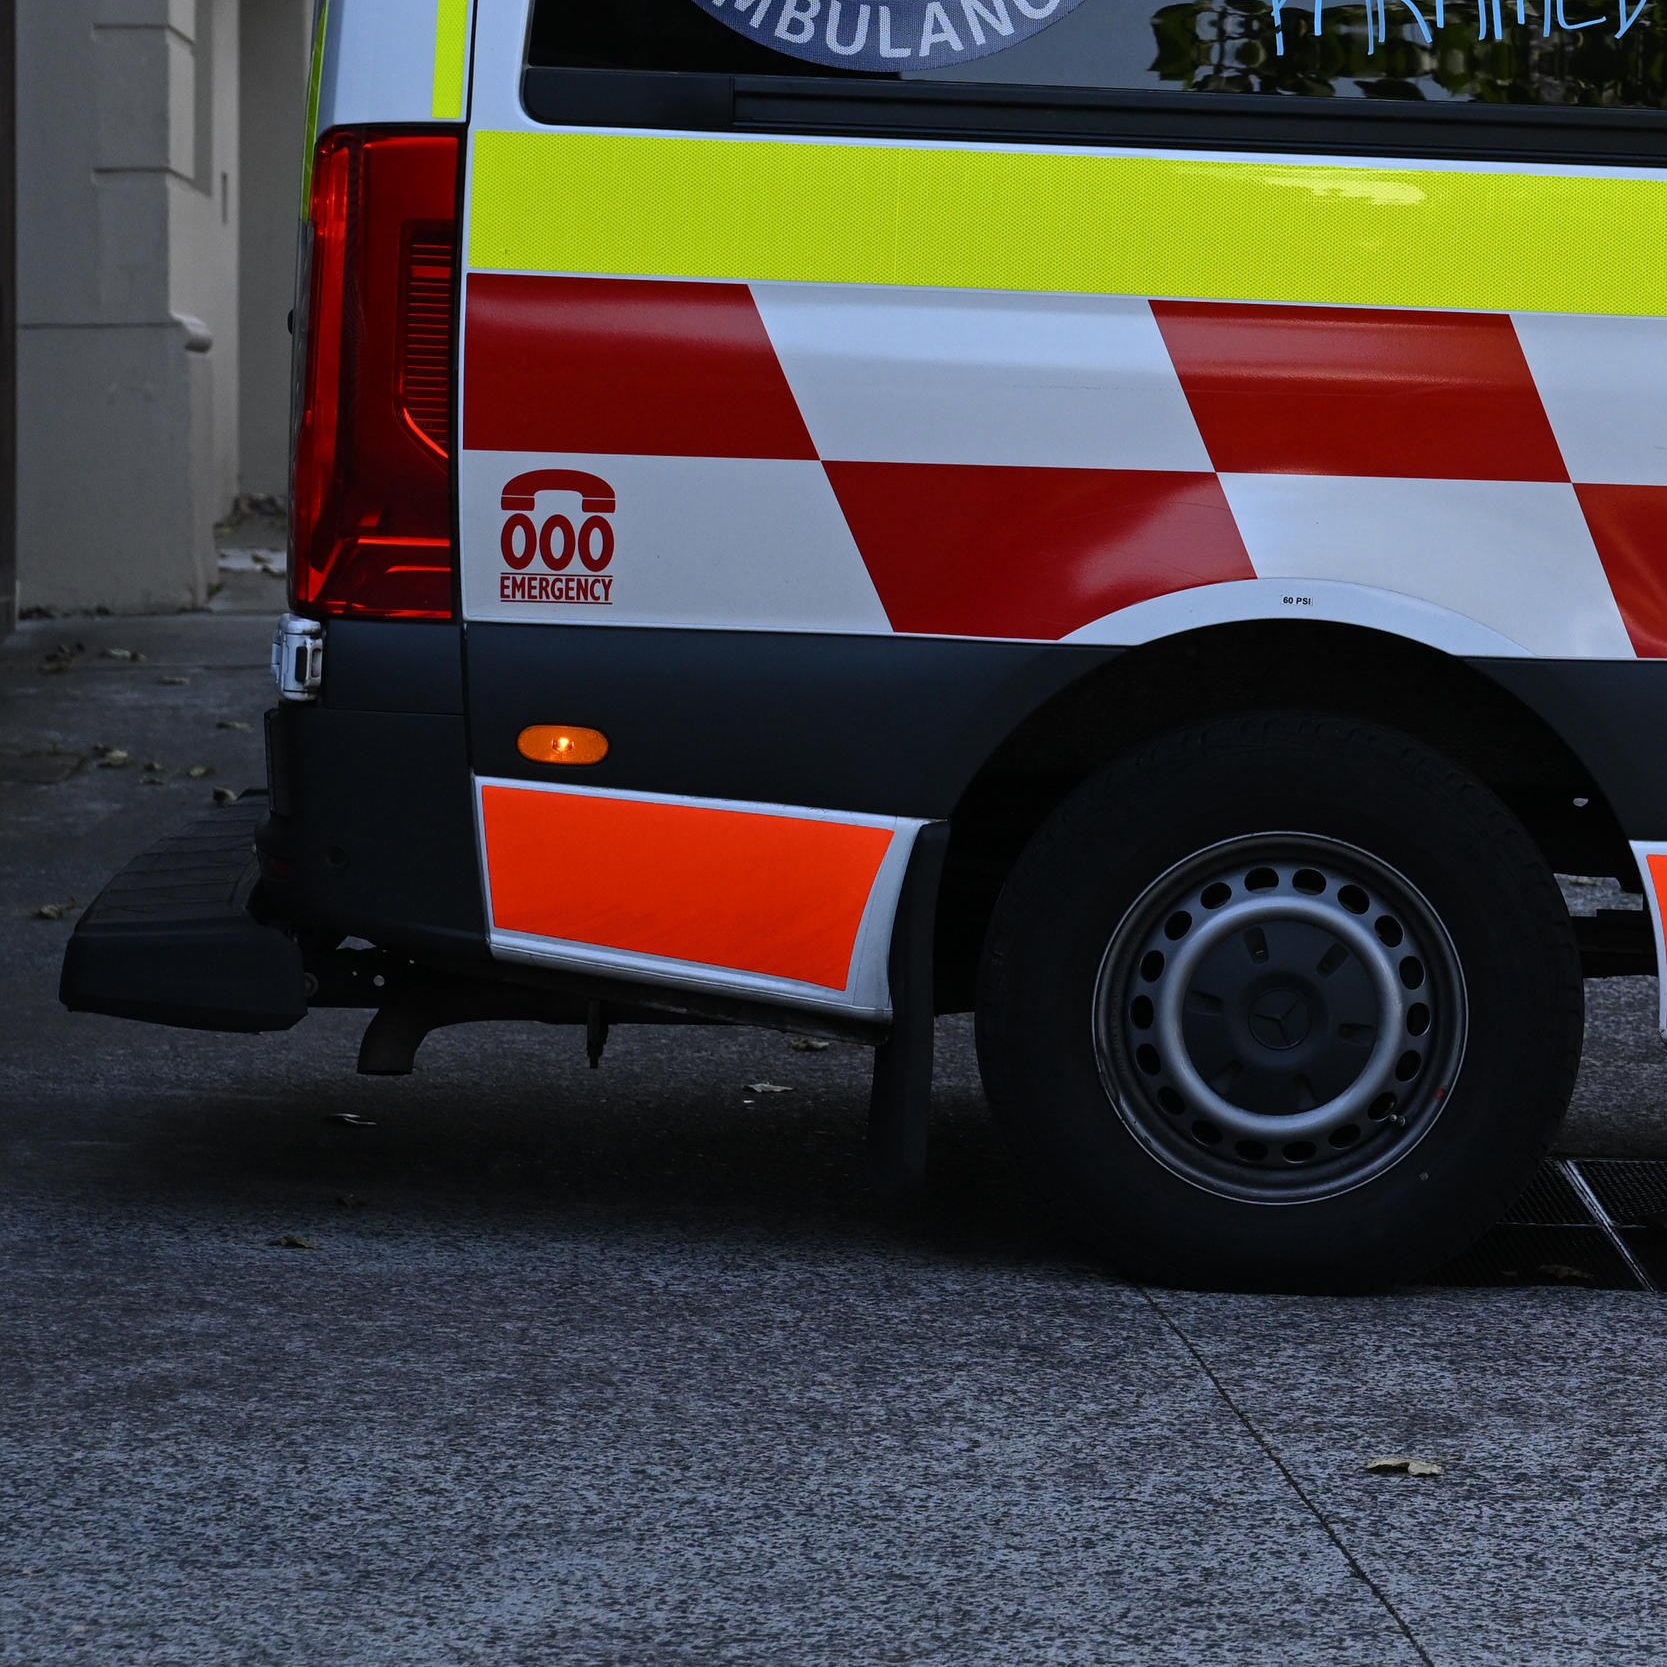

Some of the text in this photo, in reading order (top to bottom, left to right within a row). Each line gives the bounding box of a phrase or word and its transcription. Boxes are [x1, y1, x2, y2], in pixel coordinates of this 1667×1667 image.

[501, 513, 615, 572] 000
[500, 576, 613, 601] EMERGENCY
[1282, 596, 1311, 605] 60 PSI
